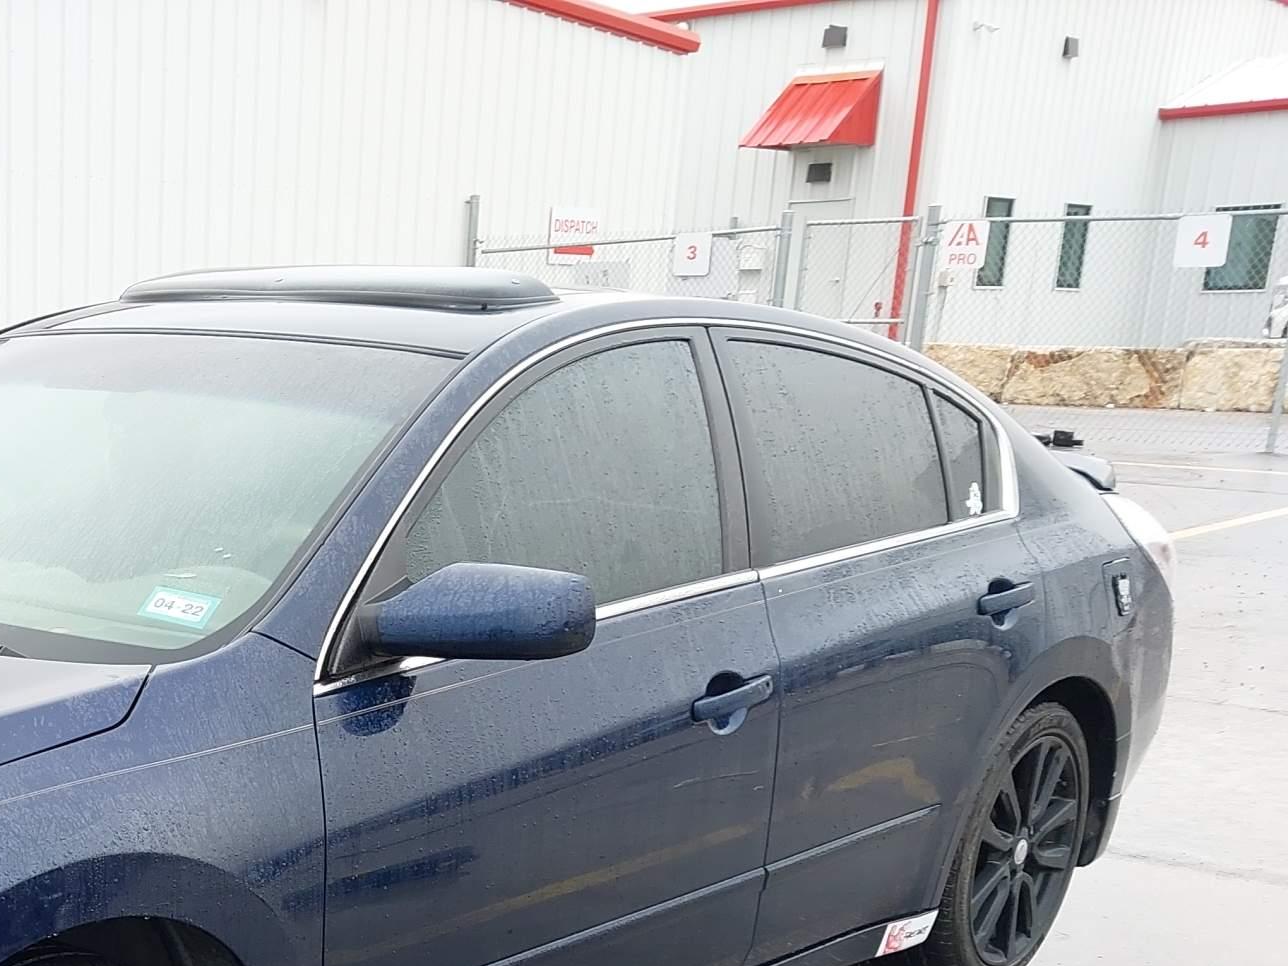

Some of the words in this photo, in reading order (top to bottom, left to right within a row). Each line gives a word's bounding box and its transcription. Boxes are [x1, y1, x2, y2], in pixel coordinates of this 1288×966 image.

[554, 218, 598, 234] DISPATCH
[1193, 230, 1210, 249] 4
[686, 245, 698, 260] 3
[948, 253, 977, 265] PRO
